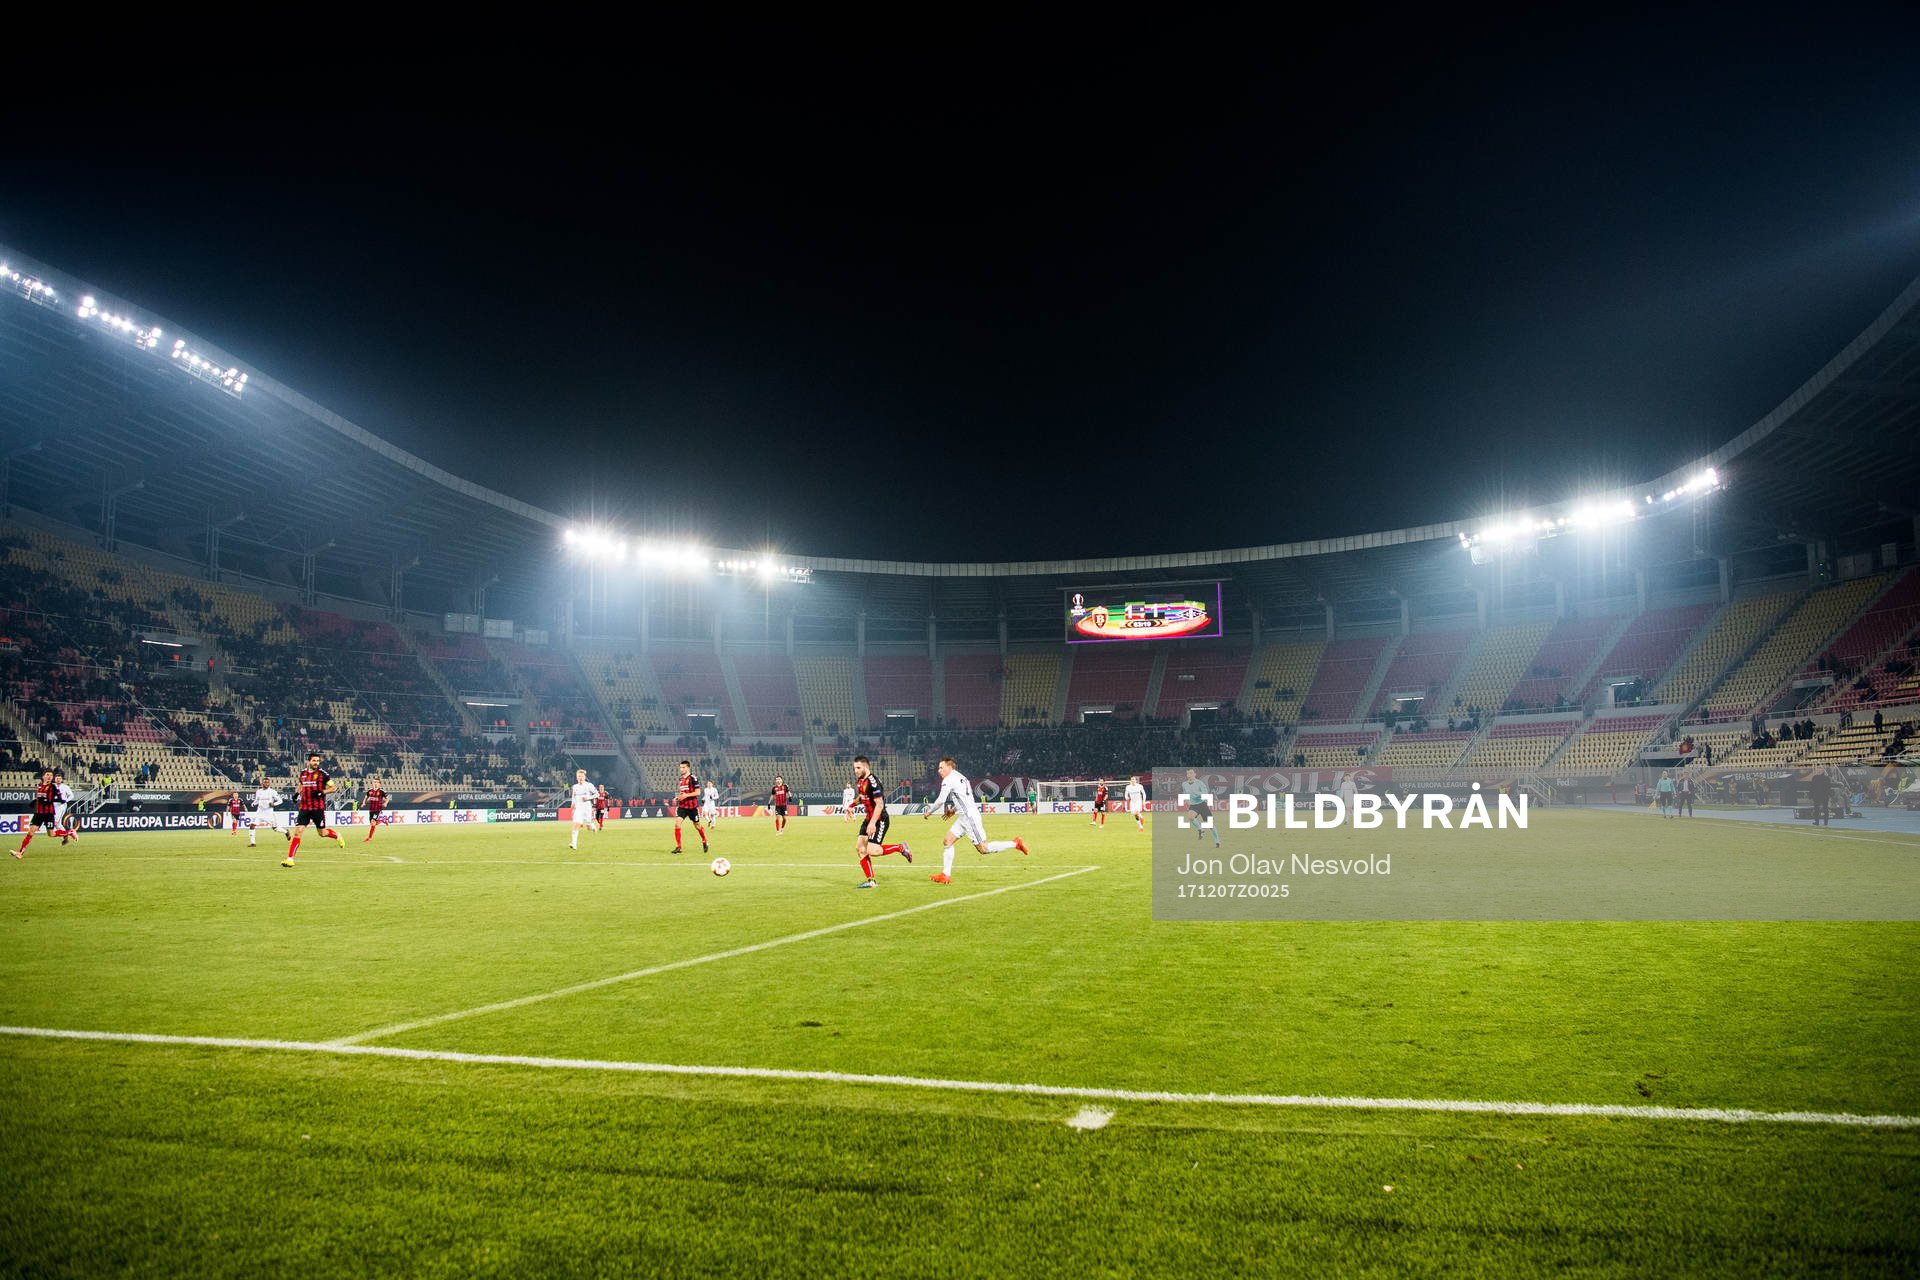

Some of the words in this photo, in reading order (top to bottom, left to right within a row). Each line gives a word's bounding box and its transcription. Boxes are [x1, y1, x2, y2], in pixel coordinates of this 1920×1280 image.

[0, 792, 31, 800] UROPA
[976, 803, 997, 813] dEx
[1009, 803, 1032, 813] FedE
[1052, 802, 1084, 813] FedEx
[1124, 800, 1178, 812] UCredit
[81, 816, 114, 829] UEFA
[117, 815, 163, 829] EUROPA
[165, 814, 208, 827] LEAGUE
[335, 811, 365, 825] FedEx
[417, 811, 443, 823] FedEx
[453, 810, 478, 822] FedEx
[488, 810, 531, 821] enterprise
[0, 815, 30, 833] edE
